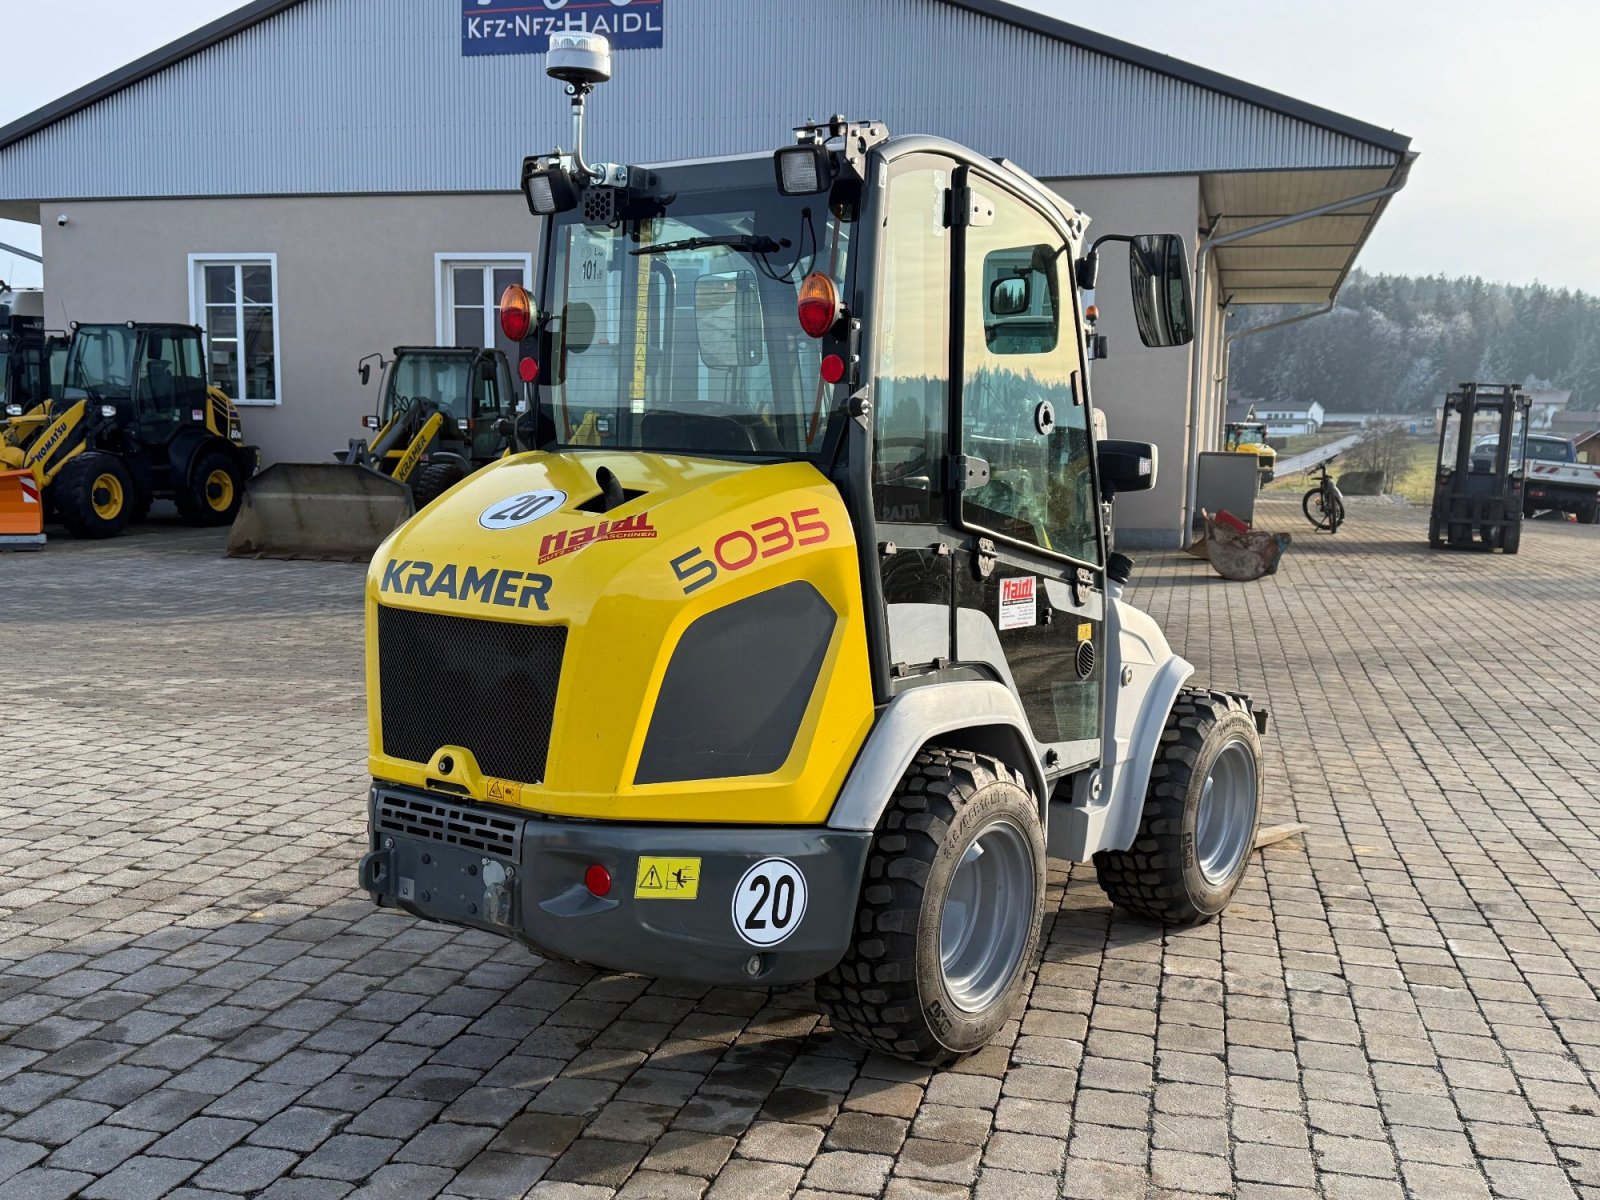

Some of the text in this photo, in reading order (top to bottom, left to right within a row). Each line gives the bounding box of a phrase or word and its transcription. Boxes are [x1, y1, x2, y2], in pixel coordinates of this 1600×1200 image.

[582, 260, 597, 280] 101
[30, 422, 67, 463] KOMATSU
[399, 435, 427, 481] KRAMER
[488, 495, 555, 521] 20
[669, 507, 830, 595] 5035
[381, 559, 553, 611] KRAMER
[744, 874, 796, 930] 20
